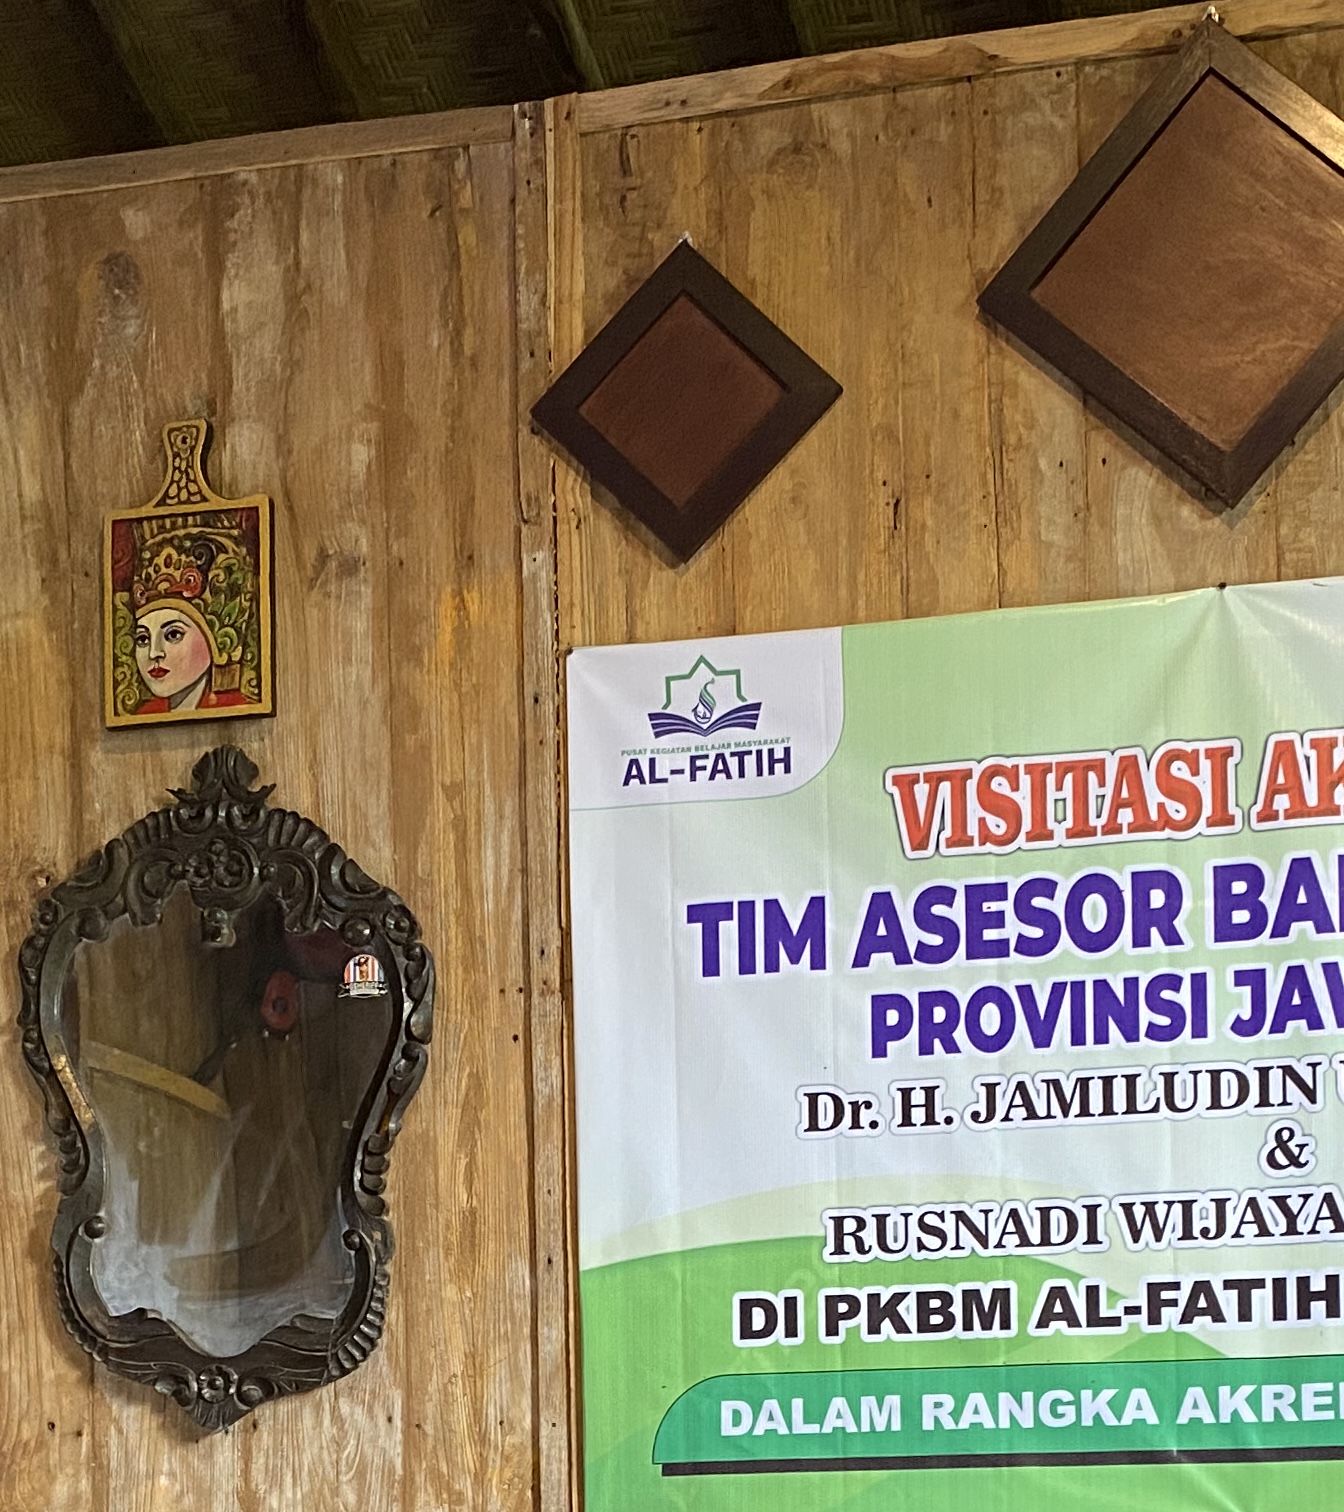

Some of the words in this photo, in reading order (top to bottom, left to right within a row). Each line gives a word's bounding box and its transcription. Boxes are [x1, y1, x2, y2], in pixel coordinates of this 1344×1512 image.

[621, 748, 648, 757] PUSAT
[650, 746, 692, 755] KEGIATAN
[694, 742, 732, 752] BELAJAR
[734, 736, 791, 749] MASYARAKAT
[622, 746, 792, 786] AL-FATIH
[892, 746, 1234, 852] VISITASI
[686, 895, 826, 977] TIM
[852, 869, 1184, 968] ASESOR
[871, 972, 1208, 1059] PROVINSI
[803, 1091, 879, 1133] Dr.
[896, 1085, 954, 1128] H.
[970, 1060, 1322, 1124] JAMILUDIN
[1266, 1126, 1310, 1171] &
[828, 1203, 1103, 1258] RUSNADI
[738, 1296, 799, 1341] DI
[824, 1286, 1012, 1338] PKBM
[1035, 1273, 1342, 1330] AL-FATIH
[720, 1394, 902, 1437] DALAM
[922, 1387, 1160, 1431] RANGKA
